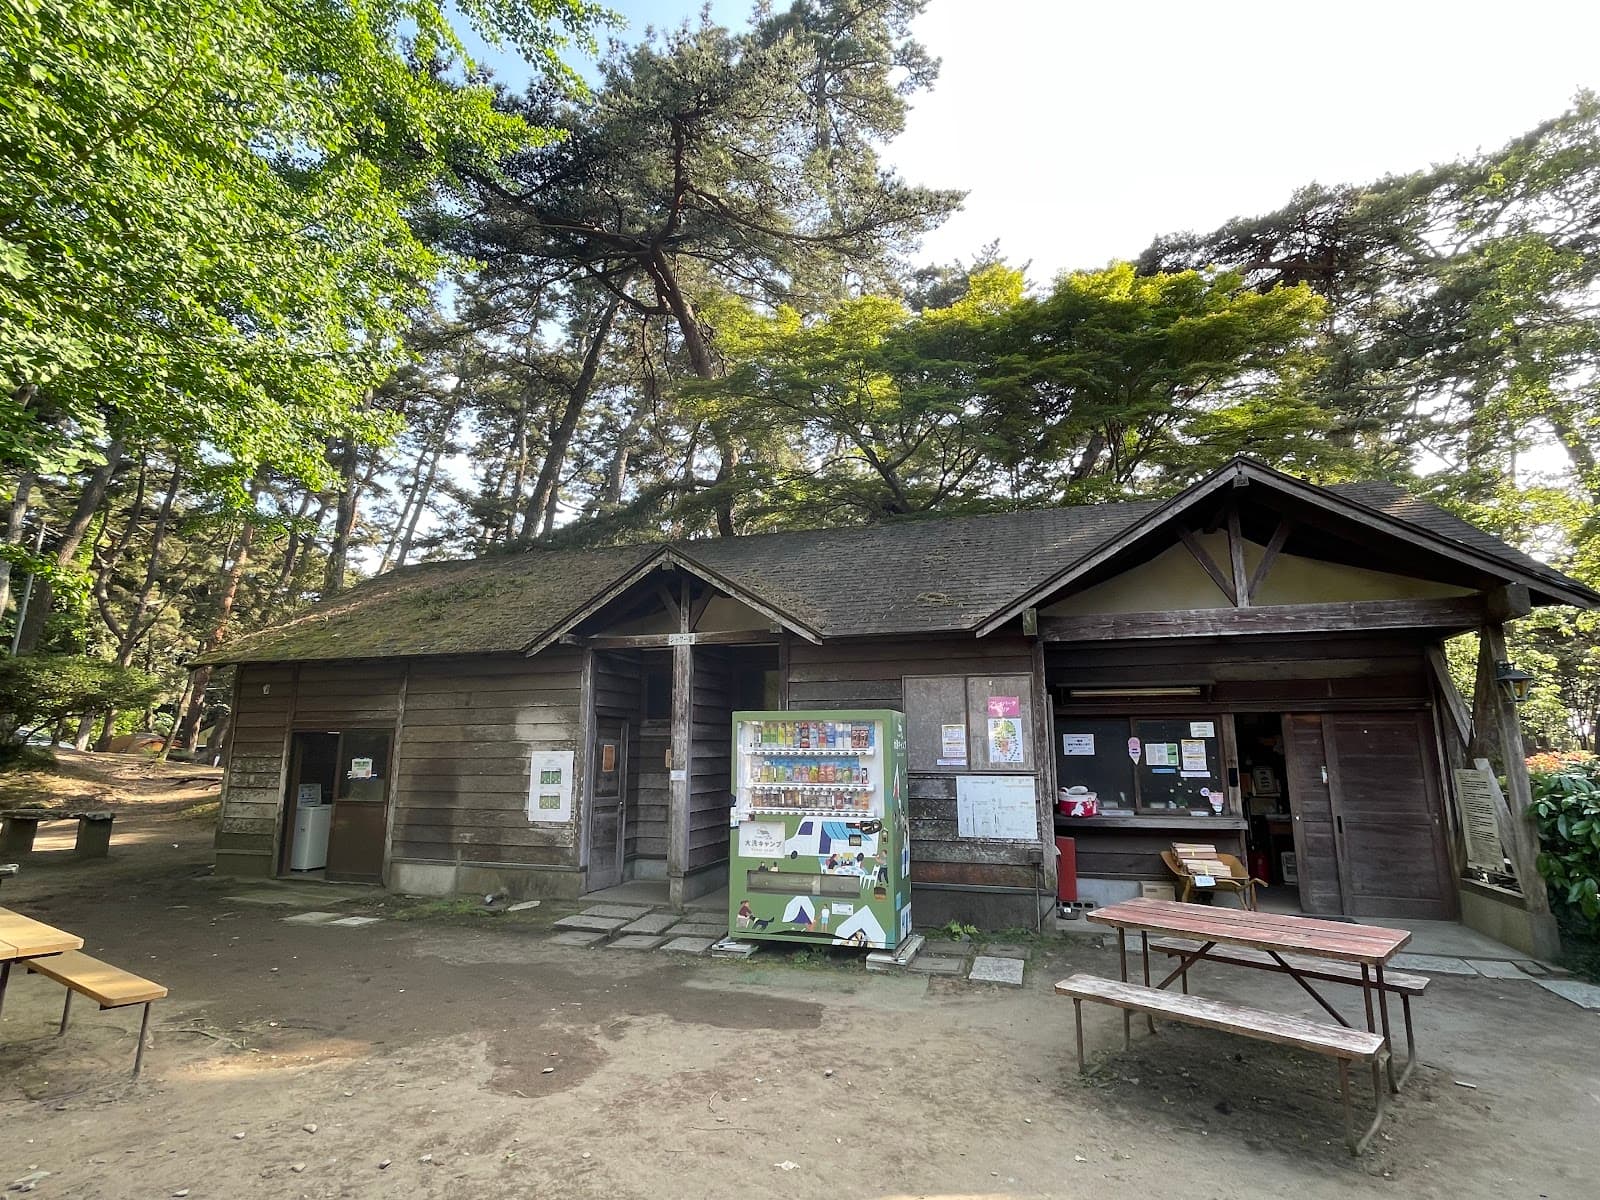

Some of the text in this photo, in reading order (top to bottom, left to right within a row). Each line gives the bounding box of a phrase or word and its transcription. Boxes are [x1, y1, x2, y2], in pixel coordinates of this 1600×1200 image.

[744, 839, 782, 848] 大洗キャンプ
